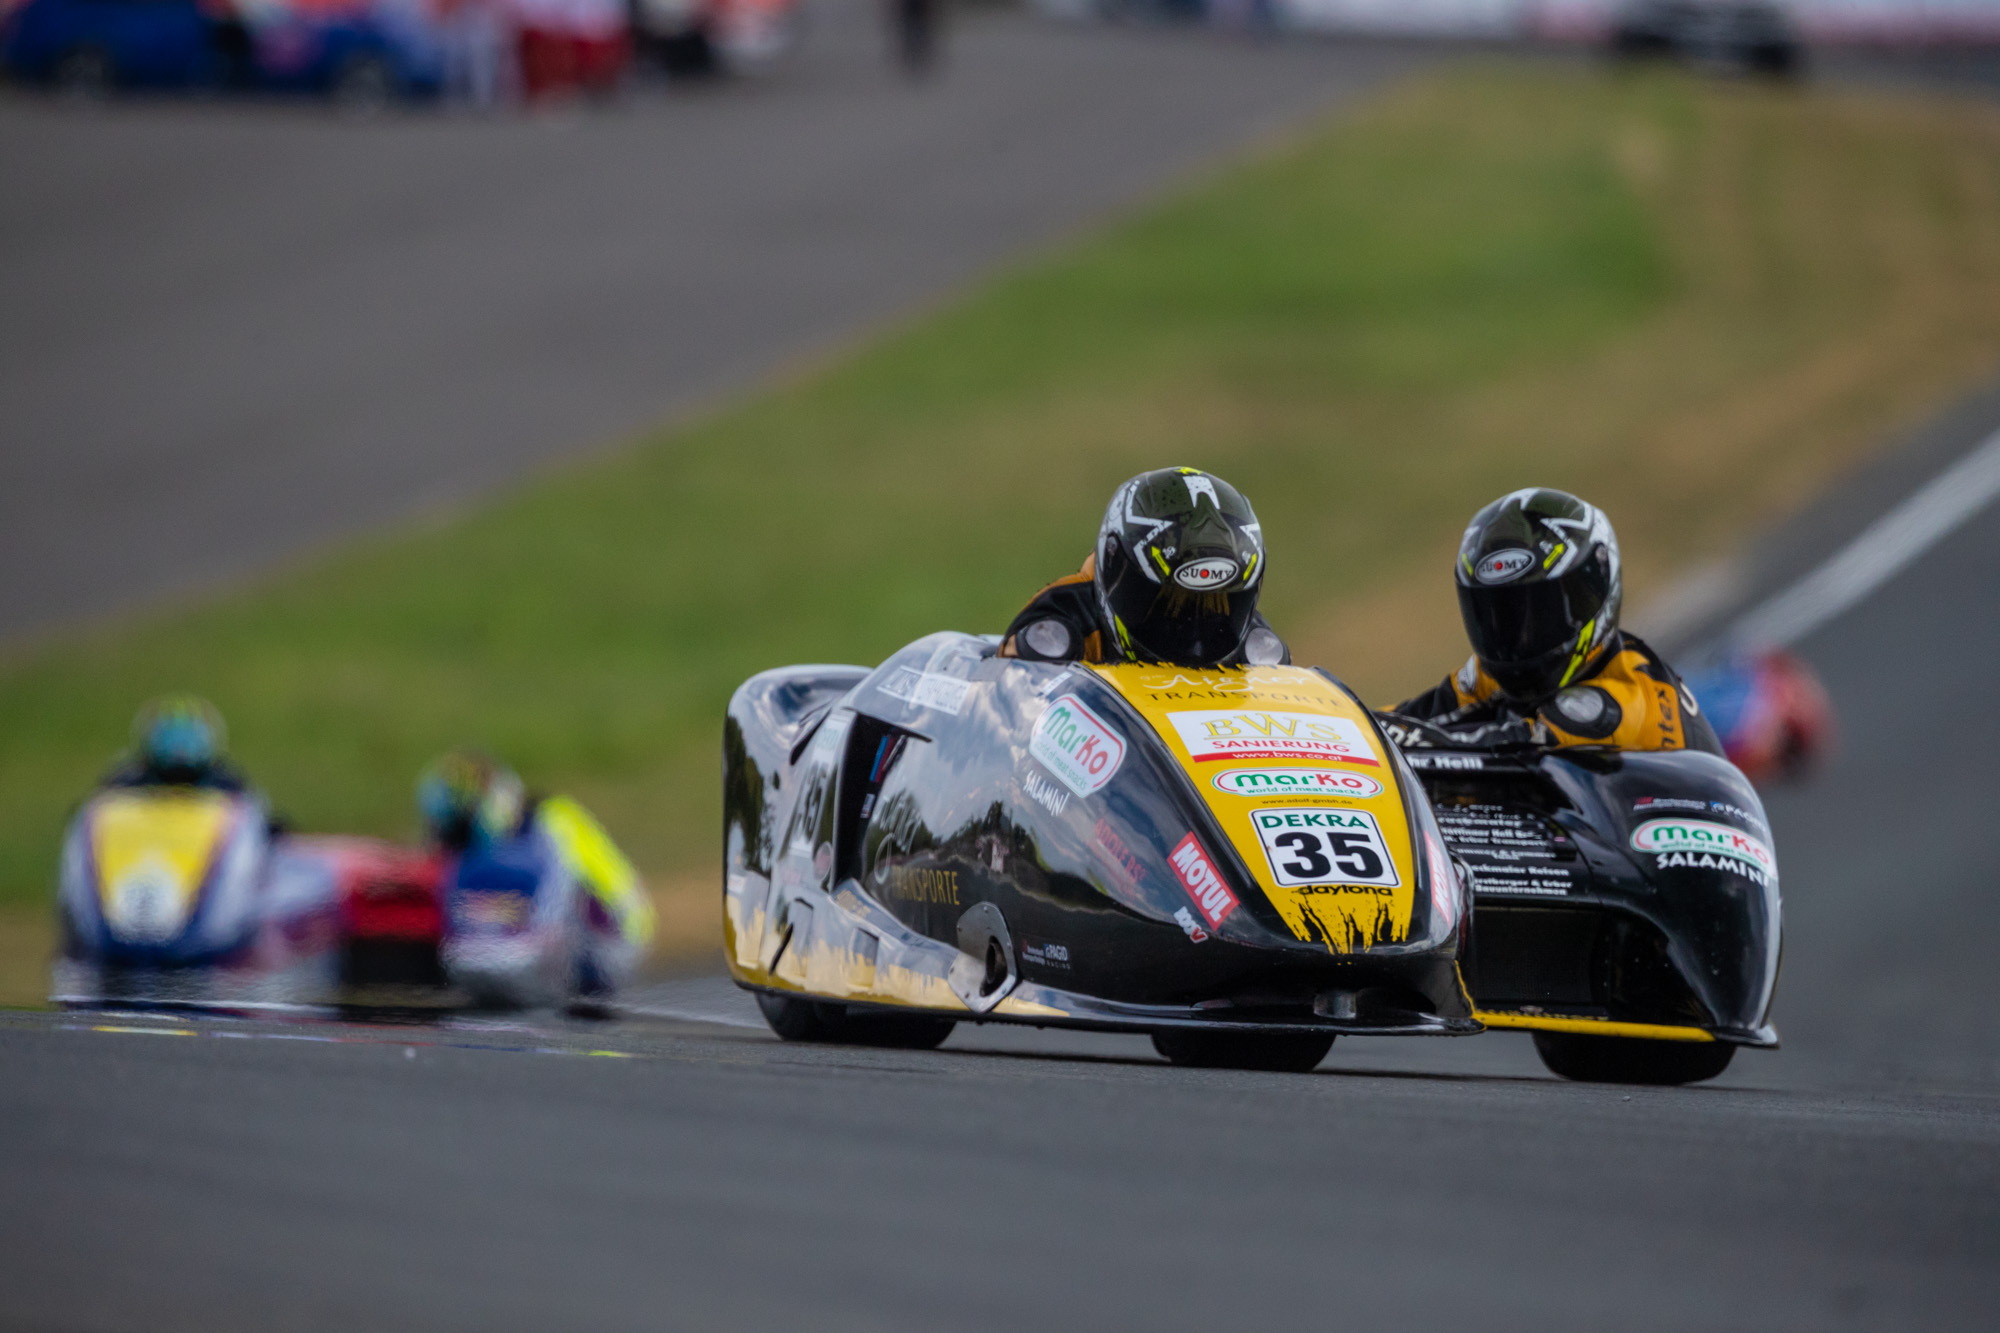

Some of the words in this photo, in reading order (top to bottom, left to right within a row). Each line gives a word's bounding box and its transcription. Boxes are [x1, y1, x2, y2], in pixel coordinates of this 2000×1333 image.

[1181, 567, 1232, 580] SUOMY
[1201, 712, 1342, 741] BWS
[1211, 739, 1350, 753] SANIERUNG
[1232, 750, 1343, 762] www.bws.co.at
[1247, 786, 1274, 794] world
[1295, 786, 1323, 794] meat
[1326, 787, 1362, 796] snacks
[1260, 814, 1370, 829] DEKRA
[1274, 831, 1384, 879] 35
[1656, 851, 1769, 887] SALAMINI
[1172, 842, 1231, 922] MOTUL
[1298, 885, 1393, 897] daytona
